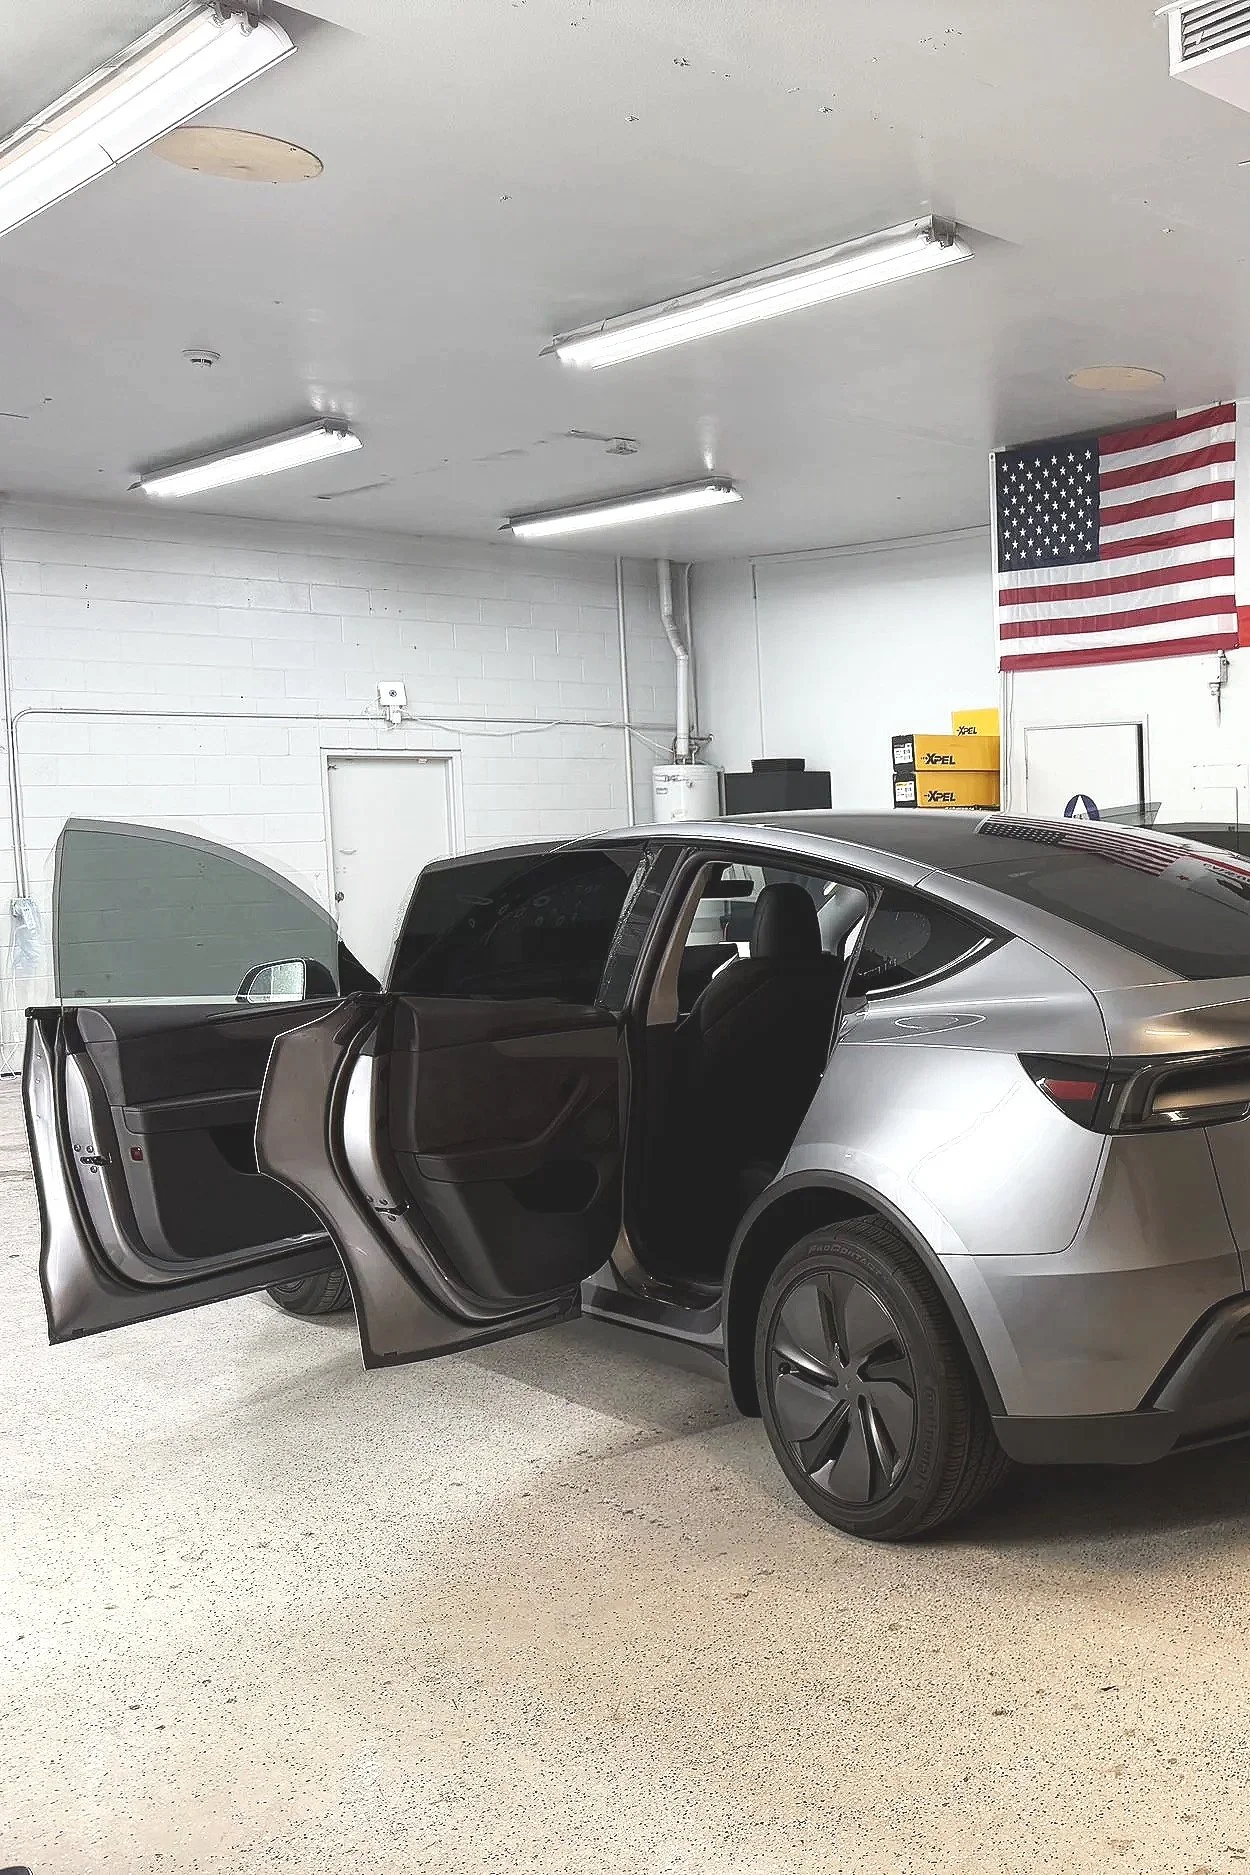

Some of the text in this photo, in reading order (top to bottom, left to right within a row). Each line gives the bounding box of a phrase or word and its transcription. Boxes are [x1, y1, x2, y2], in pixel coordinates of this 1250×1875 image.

[957, 726, 977, 736] XPEL
[924, 753, 956, 765] XPEL
[926, 791, 956, 802] XPEL
